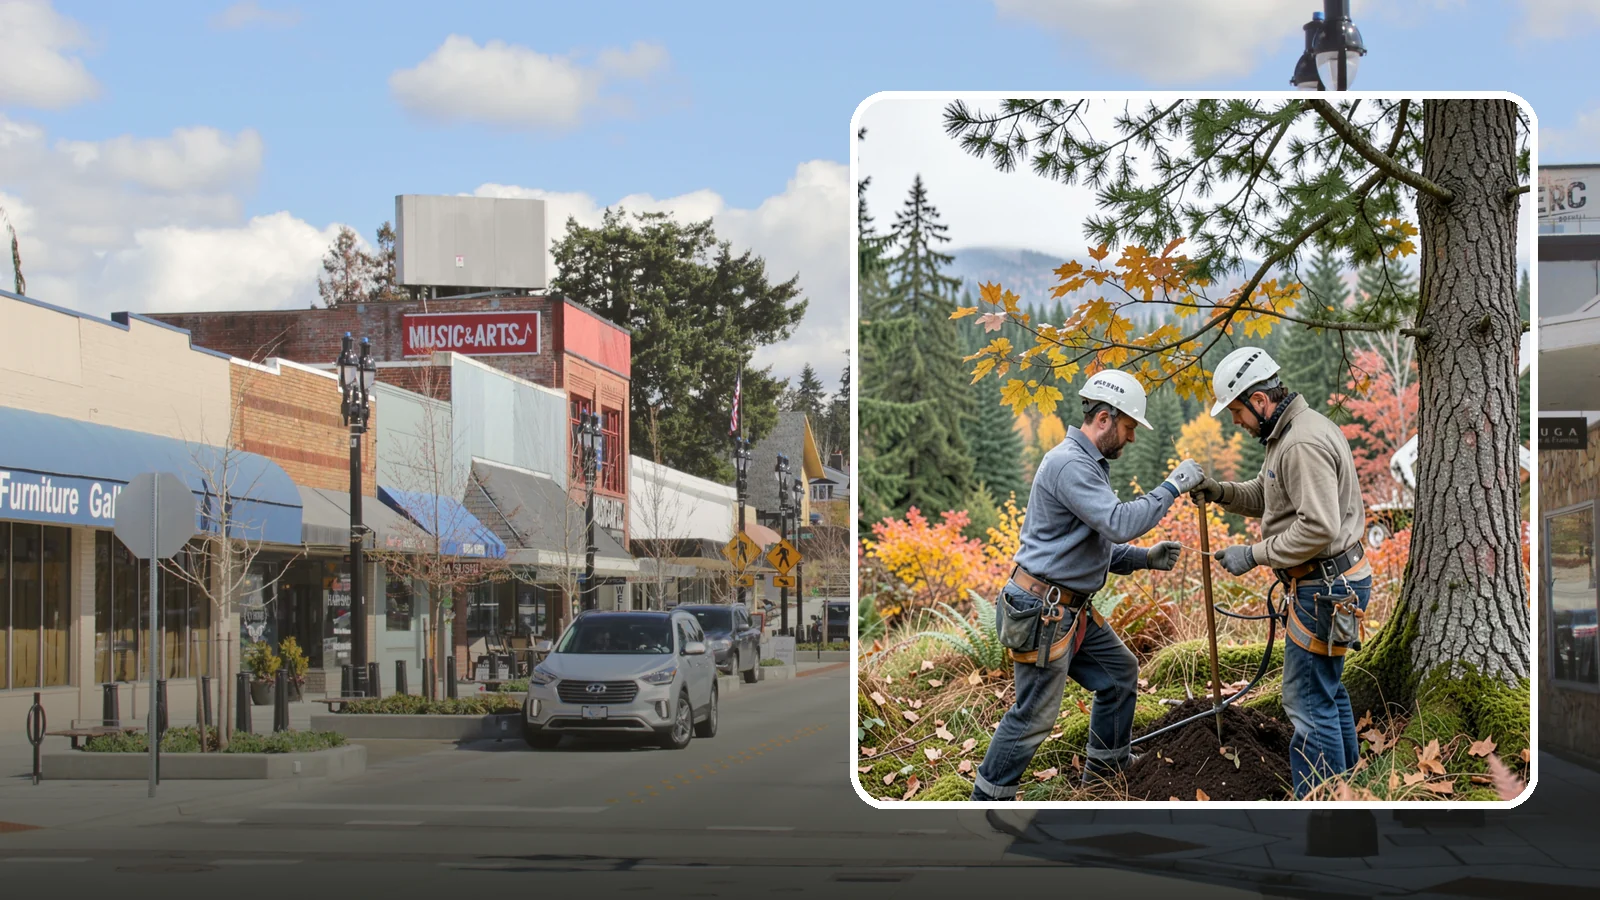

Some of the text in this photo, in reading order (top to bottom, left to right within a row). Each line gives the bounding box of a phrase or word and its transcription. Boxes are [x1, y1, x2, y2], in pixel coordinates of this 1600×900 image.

[0, 471, 122, 519] Furniture Gal
[453, 563, 479, 574] SUSHI
